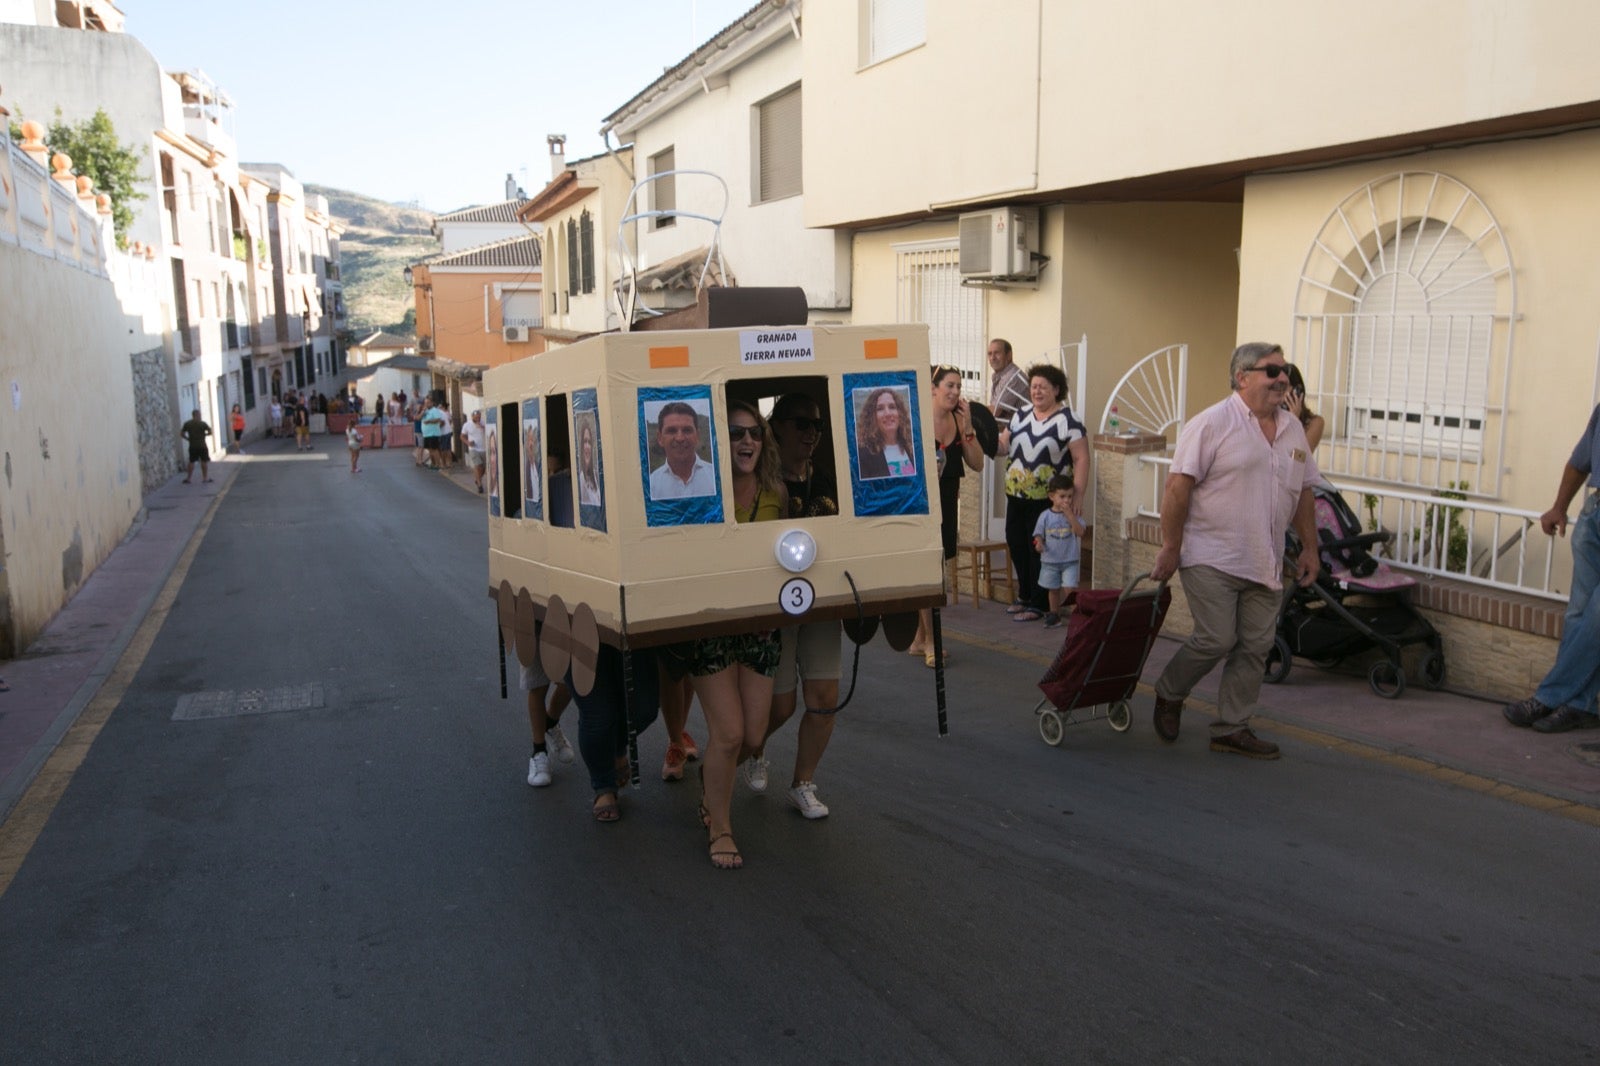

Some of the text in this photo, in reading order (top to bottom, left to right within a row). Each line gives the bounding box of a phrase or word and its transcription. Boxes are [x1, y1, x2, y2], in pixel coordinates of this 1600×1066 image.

[757, 332, 797, 344] GRANADA
[745, 348, 811, 361] SIERRA NEVADA
[791, 586, 804, 607] 3
